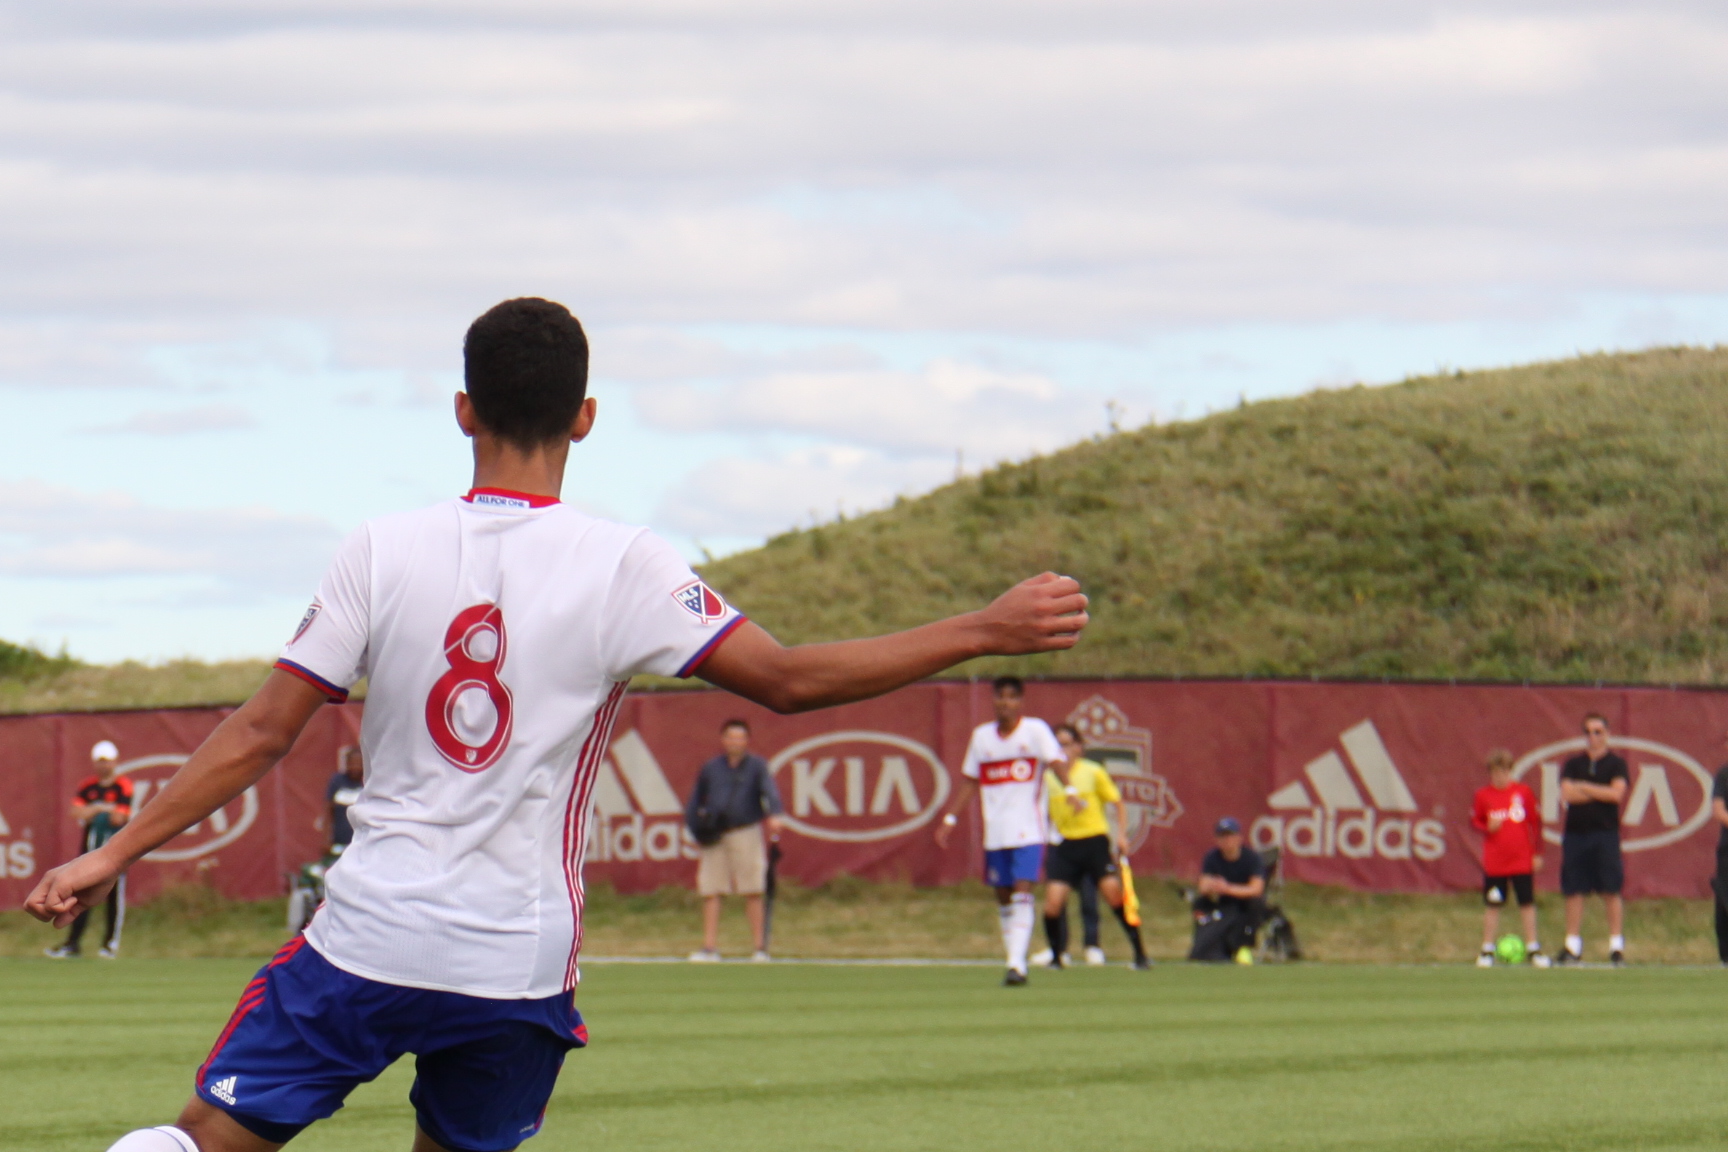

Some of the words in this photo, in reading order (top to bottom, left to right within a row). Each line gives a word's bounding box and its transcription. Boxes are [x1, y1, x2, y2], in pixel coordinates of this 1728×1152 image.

[477, 494, 490, 503] ALL
[491, 496, 507, 505] FOR
[508, 499, 524, 508] ONE
[677, 587, 699, 603] MLS
[425, 603, 514, 774] 8
[792, 756, 922, 817] KIA
[1249, 806, 1446, 861] adidas
[210, 1085, 237, 1106] adidas
